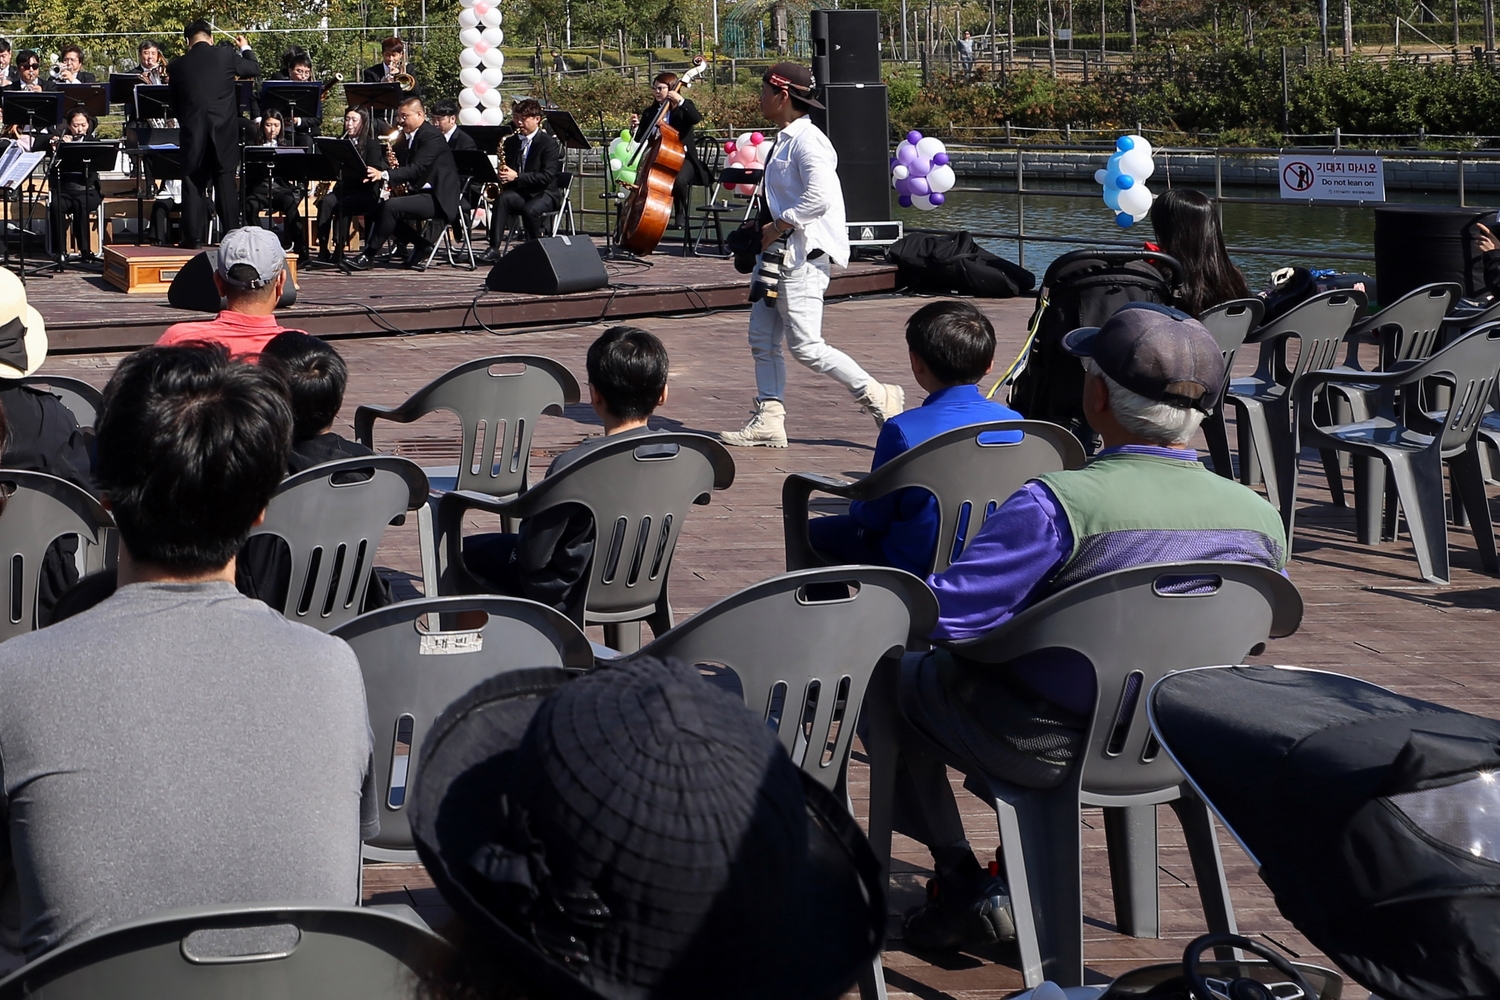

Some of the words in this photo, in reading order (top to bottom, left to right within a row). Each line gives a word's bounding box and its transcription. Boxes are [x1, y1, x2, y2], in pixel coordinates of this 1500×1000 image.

[1316, 162, 1345, 173] 기대지
[1348, 163, 1378, 174] 마시오
[1347, 179, 1362, 187] lean
